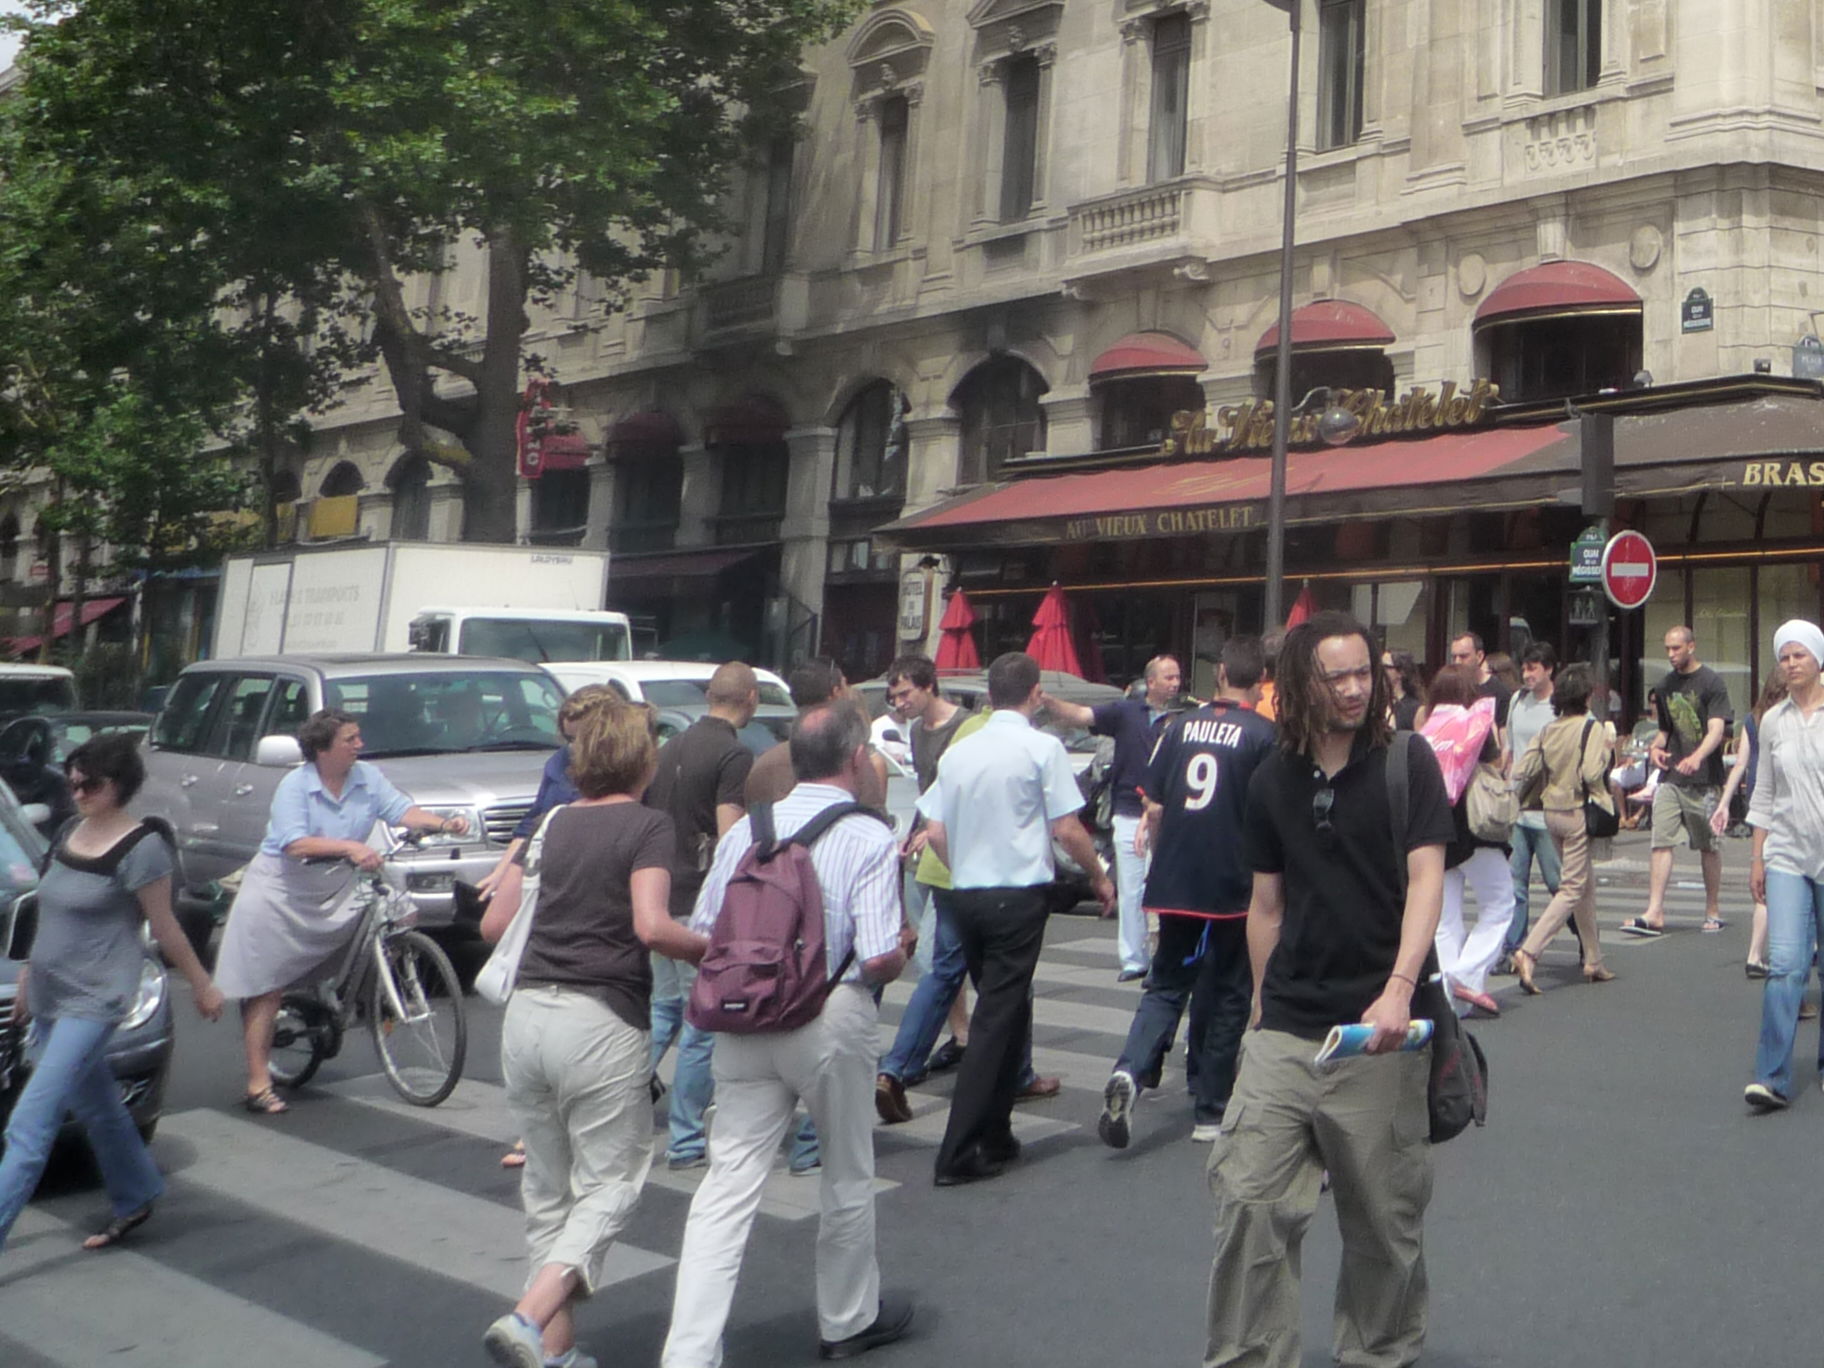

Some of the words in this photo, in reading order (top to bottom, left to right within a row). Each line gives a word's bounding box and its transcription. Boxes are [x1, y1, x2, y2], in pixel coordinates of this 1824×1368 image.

[1096, 514, 1149, 537] VIEUX
[1156, 506, 1254, 533] CHATELET
[1583, 549, 1599, 559] QUAI
[1183, 720, 1242, 749] PAULETA
[1184, 753, 1217, 810] 9
